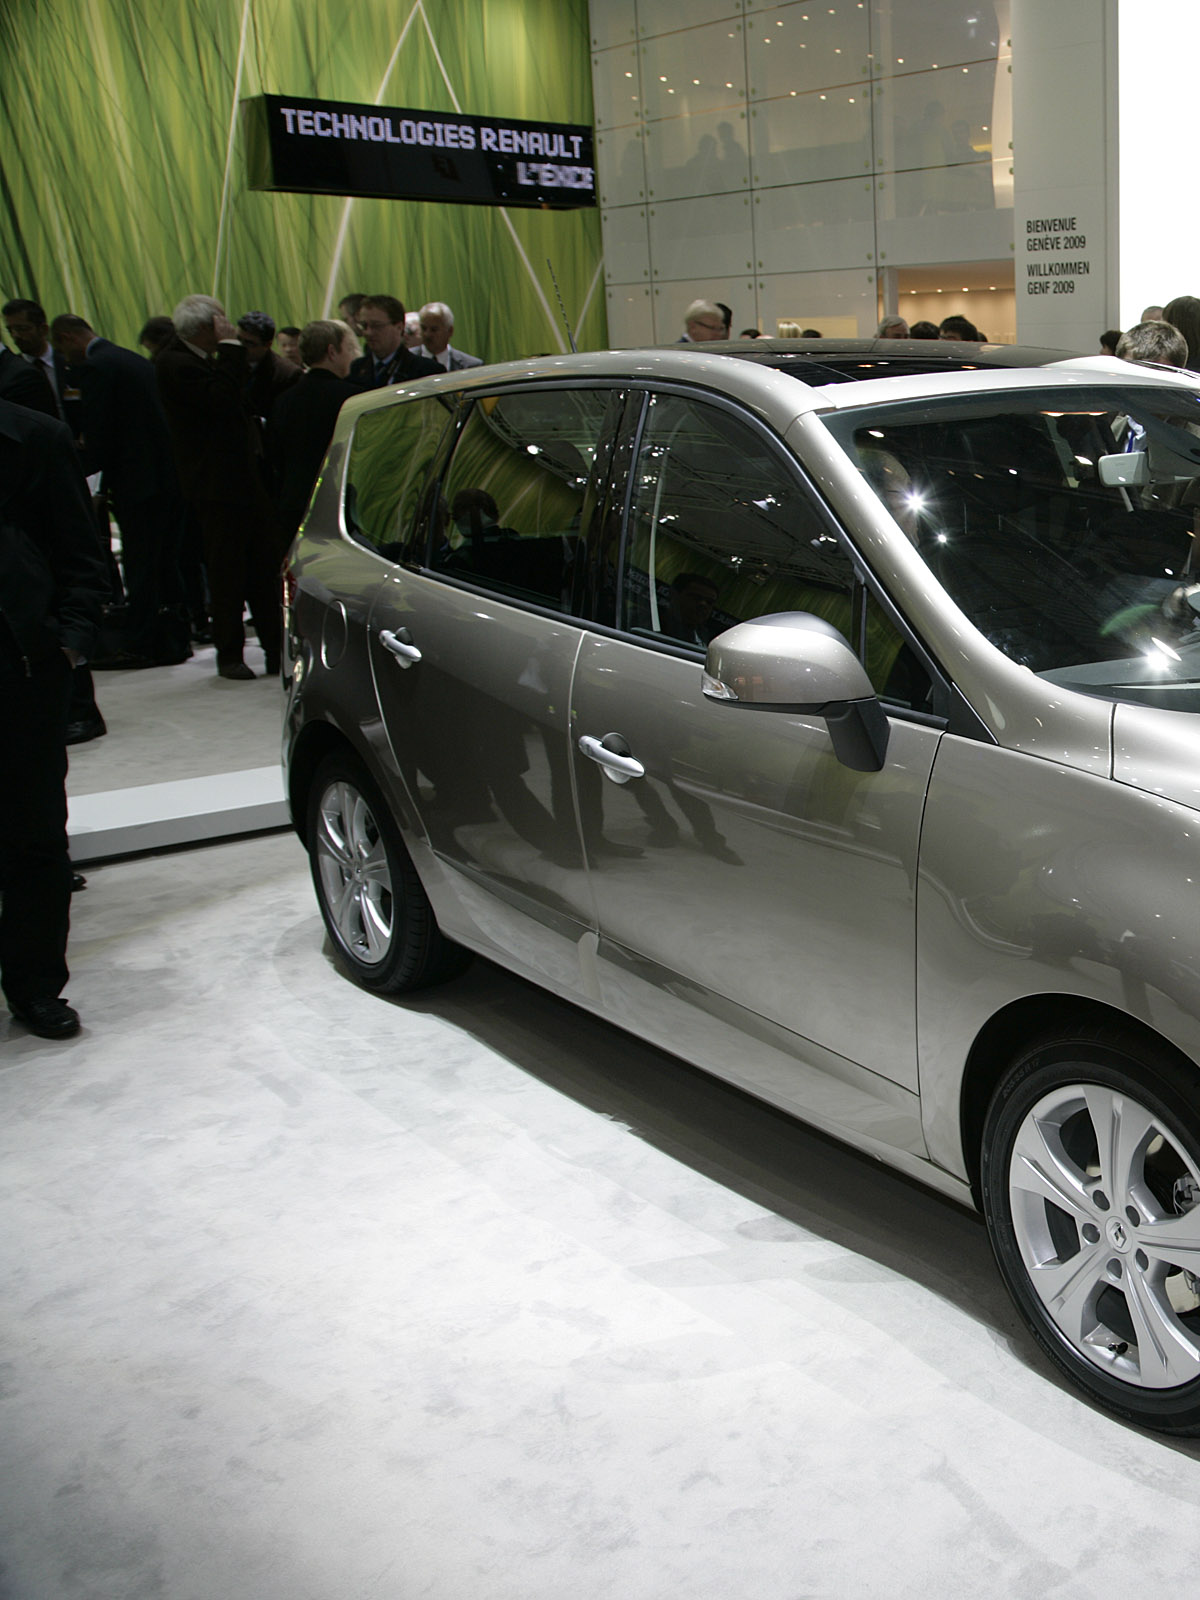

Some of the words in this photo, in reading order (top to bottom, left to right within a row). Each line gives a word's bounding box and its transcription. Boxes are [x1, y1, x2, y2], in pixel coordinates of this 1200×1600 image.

[280, 107, 476, 150] TECHNOLOGIES
[480, 127, 583, 159] RENAULT
[1026, 217, 1077, 234] BIENVENUE
[1026, 234, 1061, 251] GENÈVE
[1063, 235, 1086, 249] 2009
[1026, 261, 1090, 277] WILLKOMMEN
[1027, 281, 1050, 295] GENF
[1052, 280, 1075, 294] 2009
